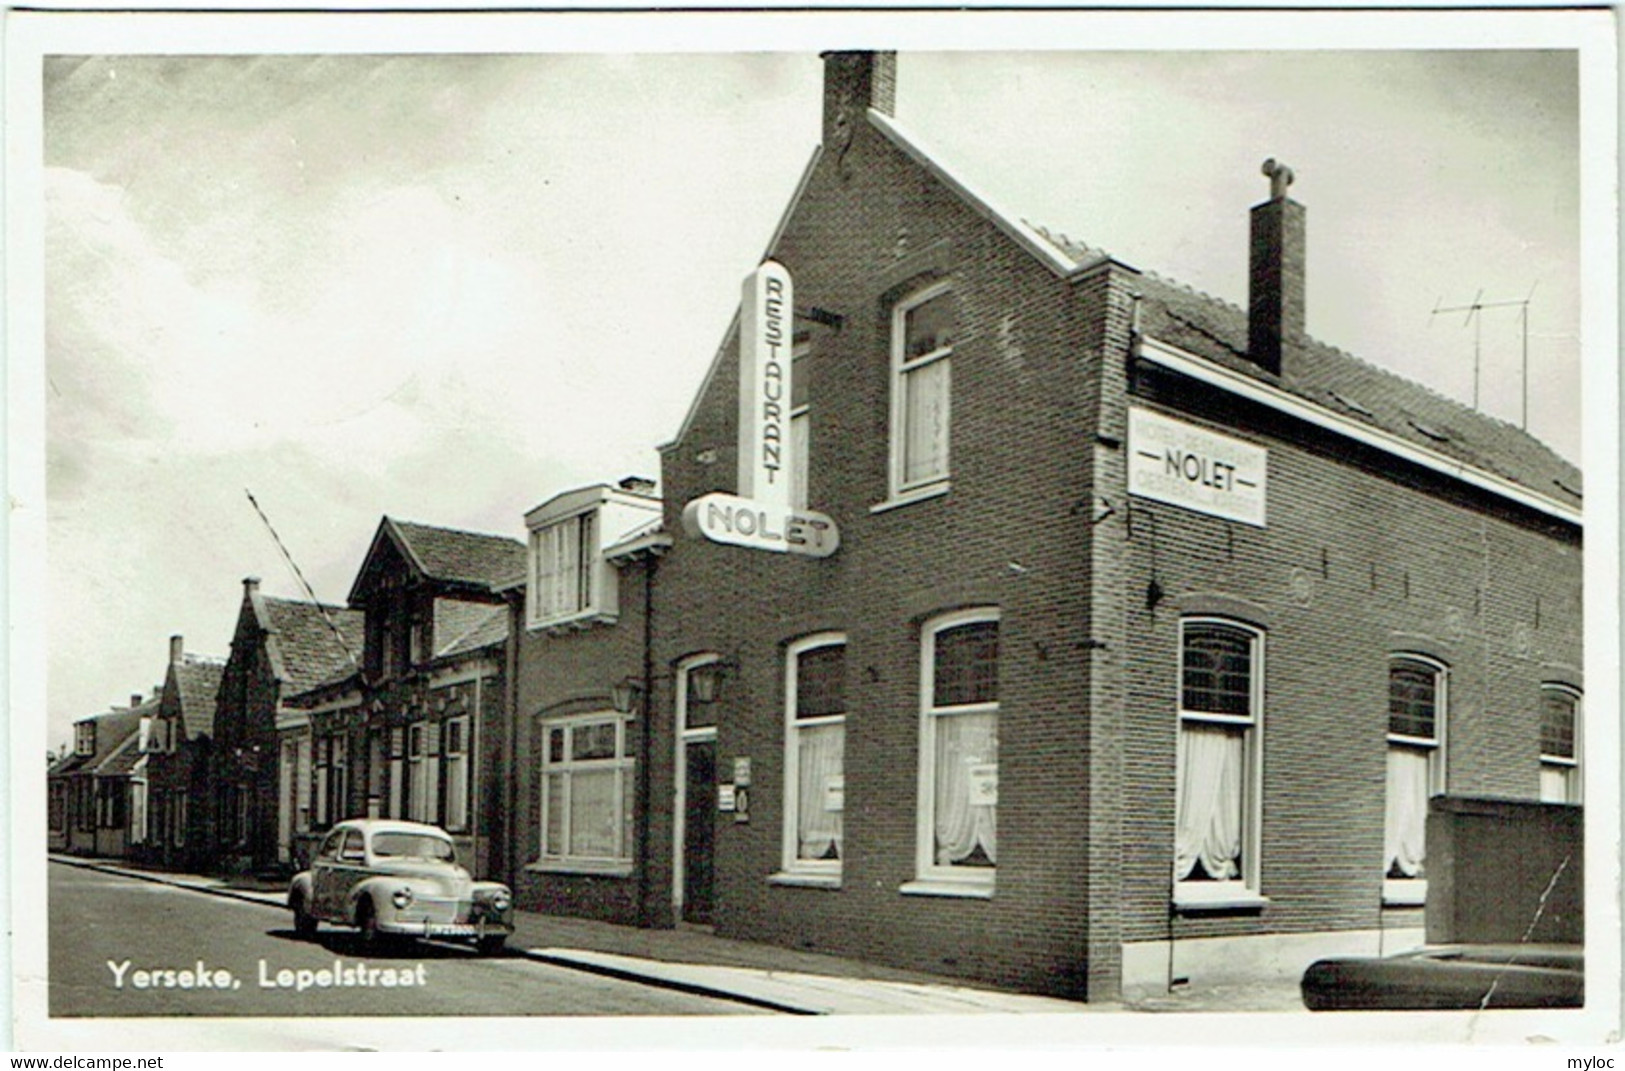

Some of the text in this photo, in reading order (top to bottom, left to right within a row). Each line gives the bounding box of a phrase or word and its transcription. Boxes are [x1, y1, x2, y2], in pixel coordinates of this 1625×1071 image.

[763, 277, 783, 484] RESTAURANT
[1165, 449, 1236, 492] NOLET
[706, 502, 829, 547] NOLET
